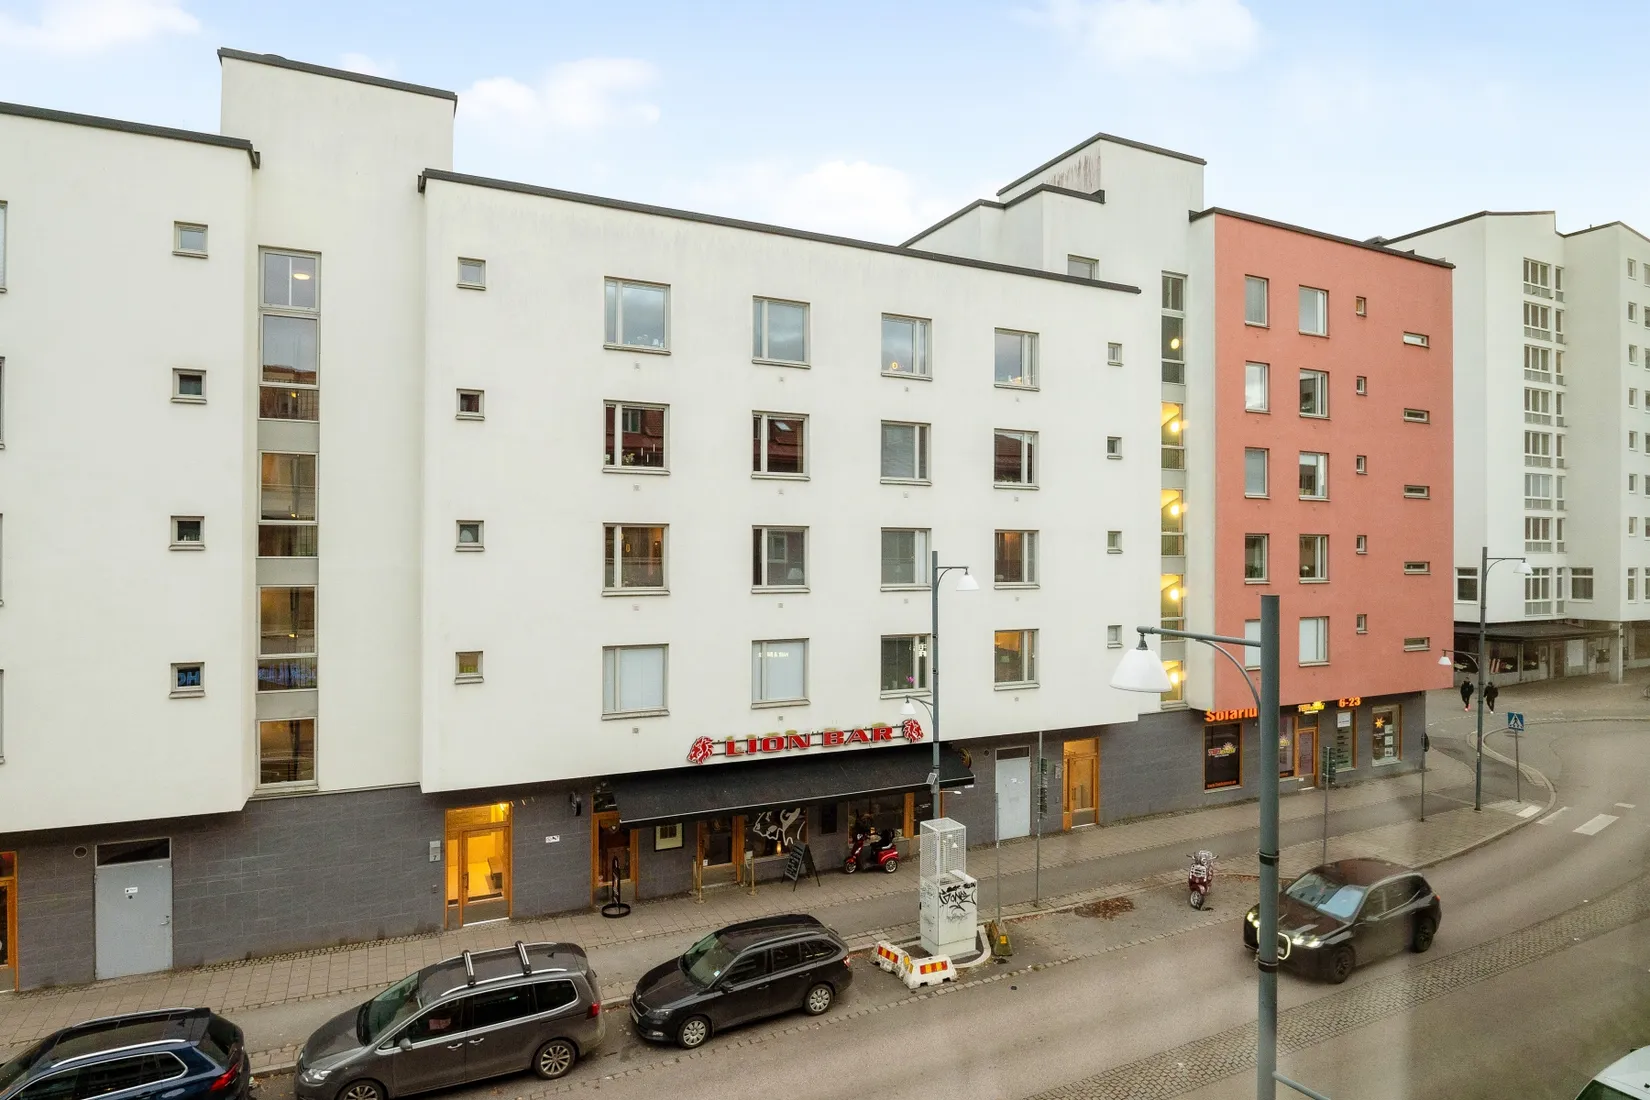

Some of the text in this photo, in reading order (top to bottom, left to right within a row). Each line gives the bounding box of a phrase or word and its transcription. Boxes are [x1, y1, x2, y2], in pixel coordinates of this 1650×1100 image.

[1339, 697, 1361, 708] 6-23
[1205, 708, 1258, 722] Solariu
[725, 726, 893, 757] LION BAR
